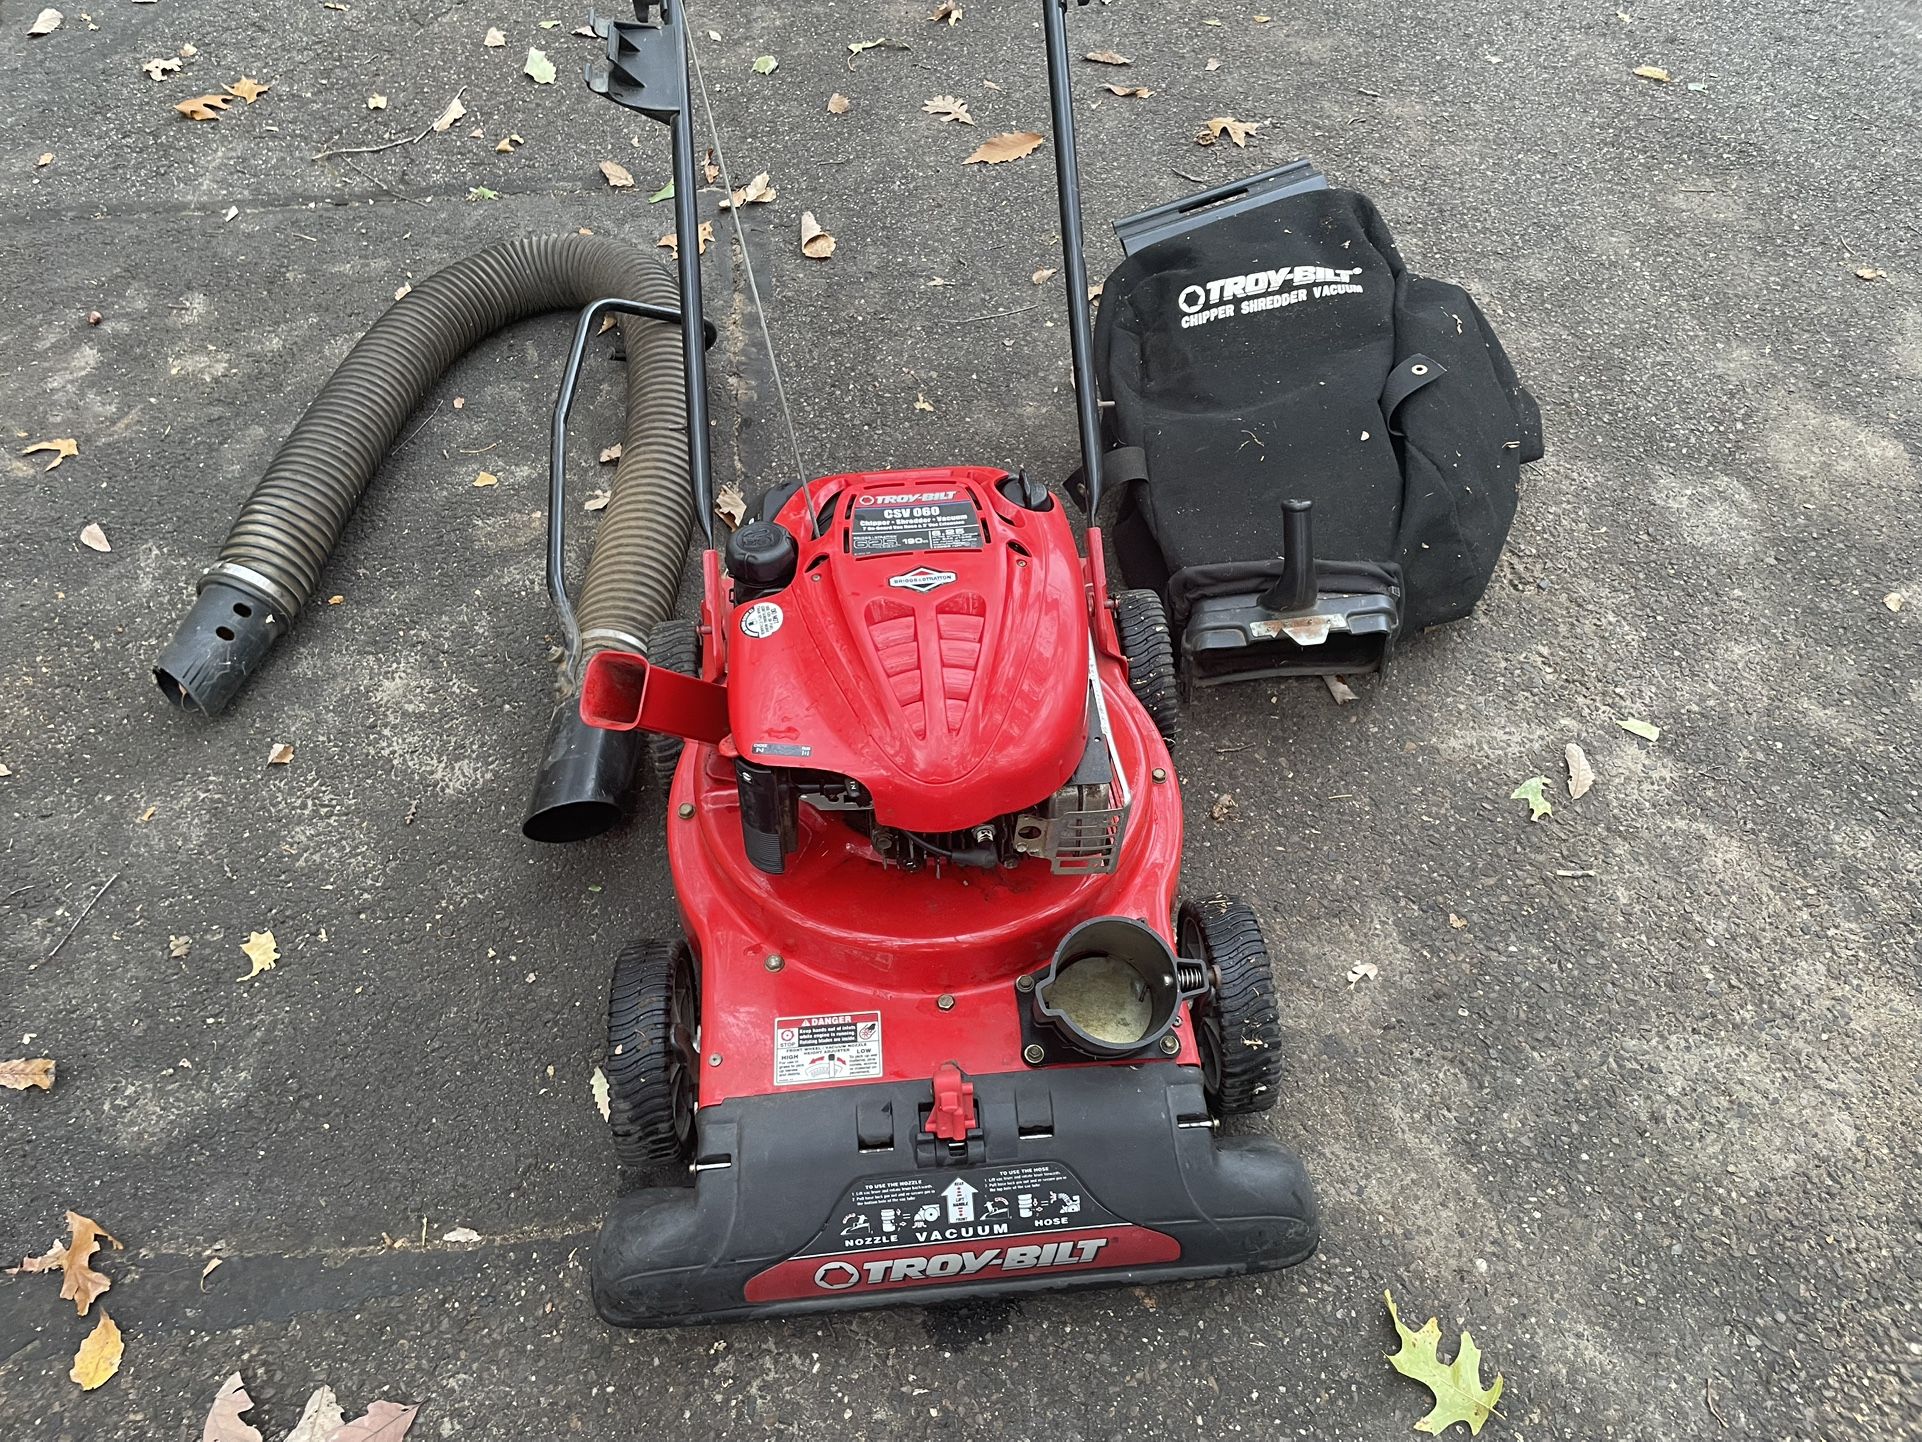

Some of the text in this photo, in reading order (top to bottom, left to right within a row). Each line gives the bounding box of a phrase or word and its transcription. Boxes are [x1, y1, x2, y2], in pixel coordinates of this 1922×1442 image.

[1180, 284, 1364, 328] CHIPPER SHREDDER VACUUM
[875, 491, 958, 504] TROY-BILT
[884, 506, 940, 518] CSV 060
[811, 1016, 852, 1026] DANGER
[1034, 1217, 1069, 1227] HOSE
[915, 1223, 1008, 1242] VACUUM
[844, 1234, 898, 1247] NOZZLE
[862, 1238, 1108, 1285] TROY-BILT
